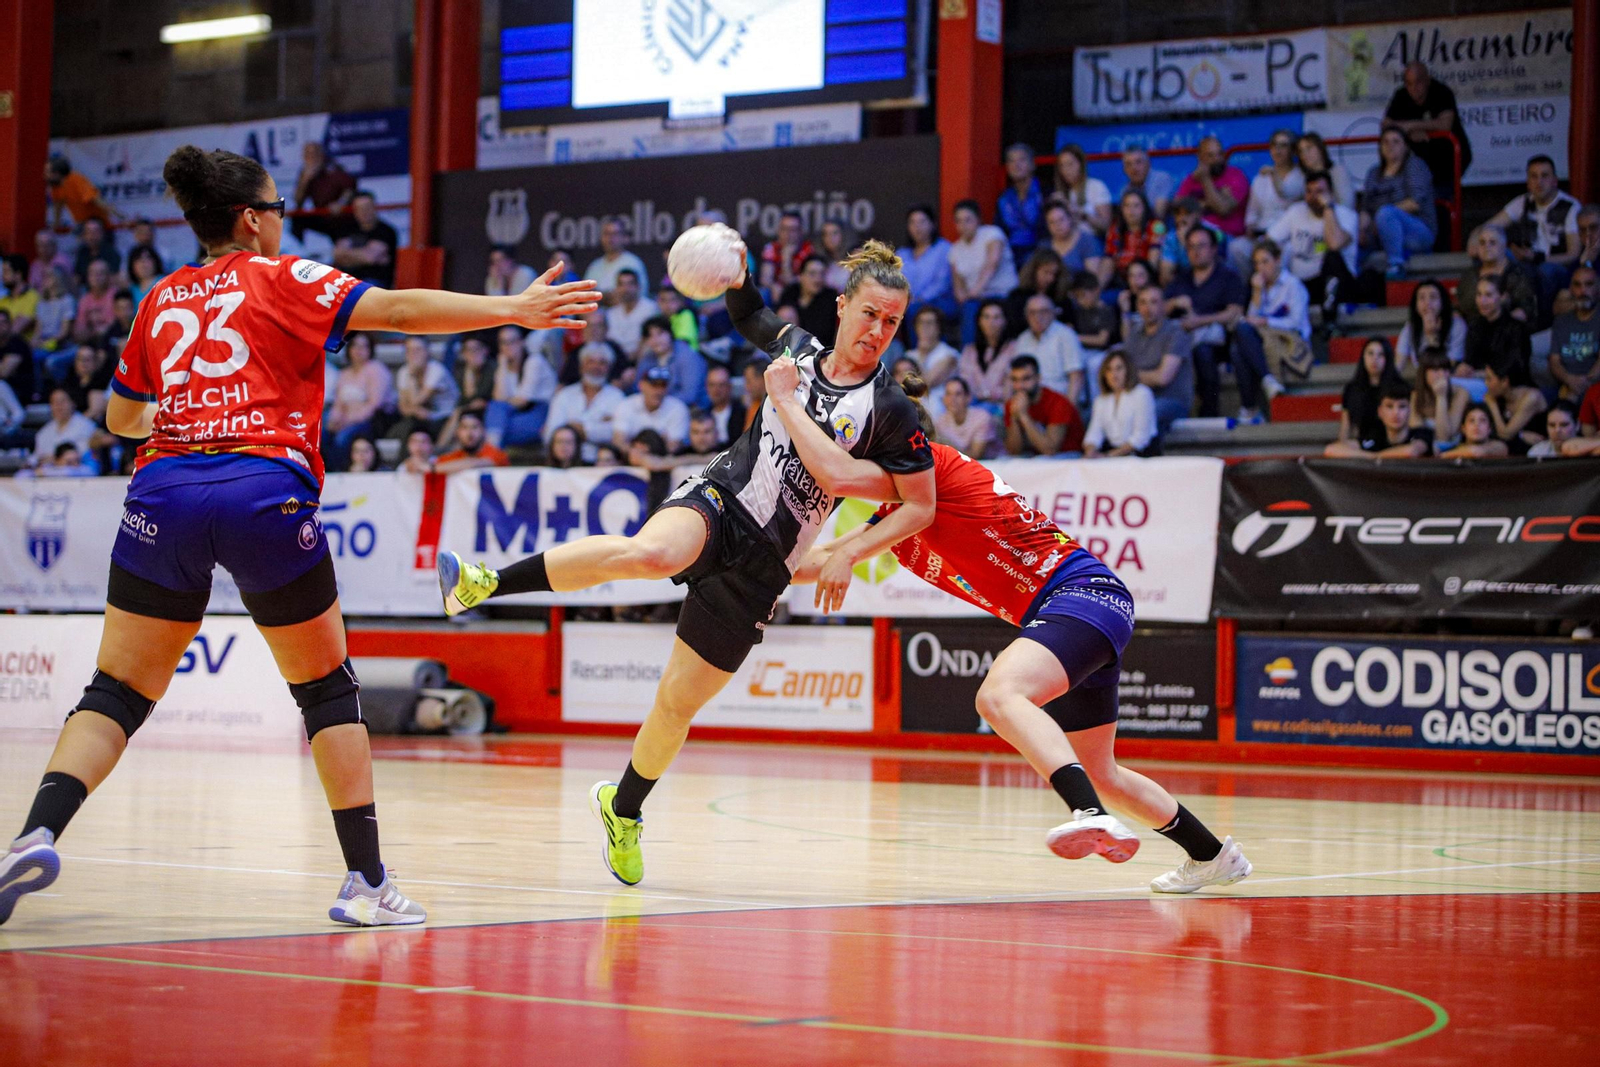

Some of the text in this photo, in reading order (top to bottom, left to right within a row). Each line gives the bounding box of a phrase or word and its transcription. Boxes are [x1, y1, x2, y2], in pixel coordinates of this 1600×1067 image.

[1081, 46, 1221, 104] Turbo
[1266, 38, 1321, 94] Pc
[151, 291, 250, 393] 23
[986, 552, 1038, 593] PipeWorks
[1069, 591, 1099, 603] natural
[1099, 599, 1109, 608] es
[569, 659, 662, 682] Recambios
[749, 661, 863, 708] Campo
[1310, 646, 1600, 713] CODISOIL
[1421, 708, 1600, 749] GASÓLEOS
